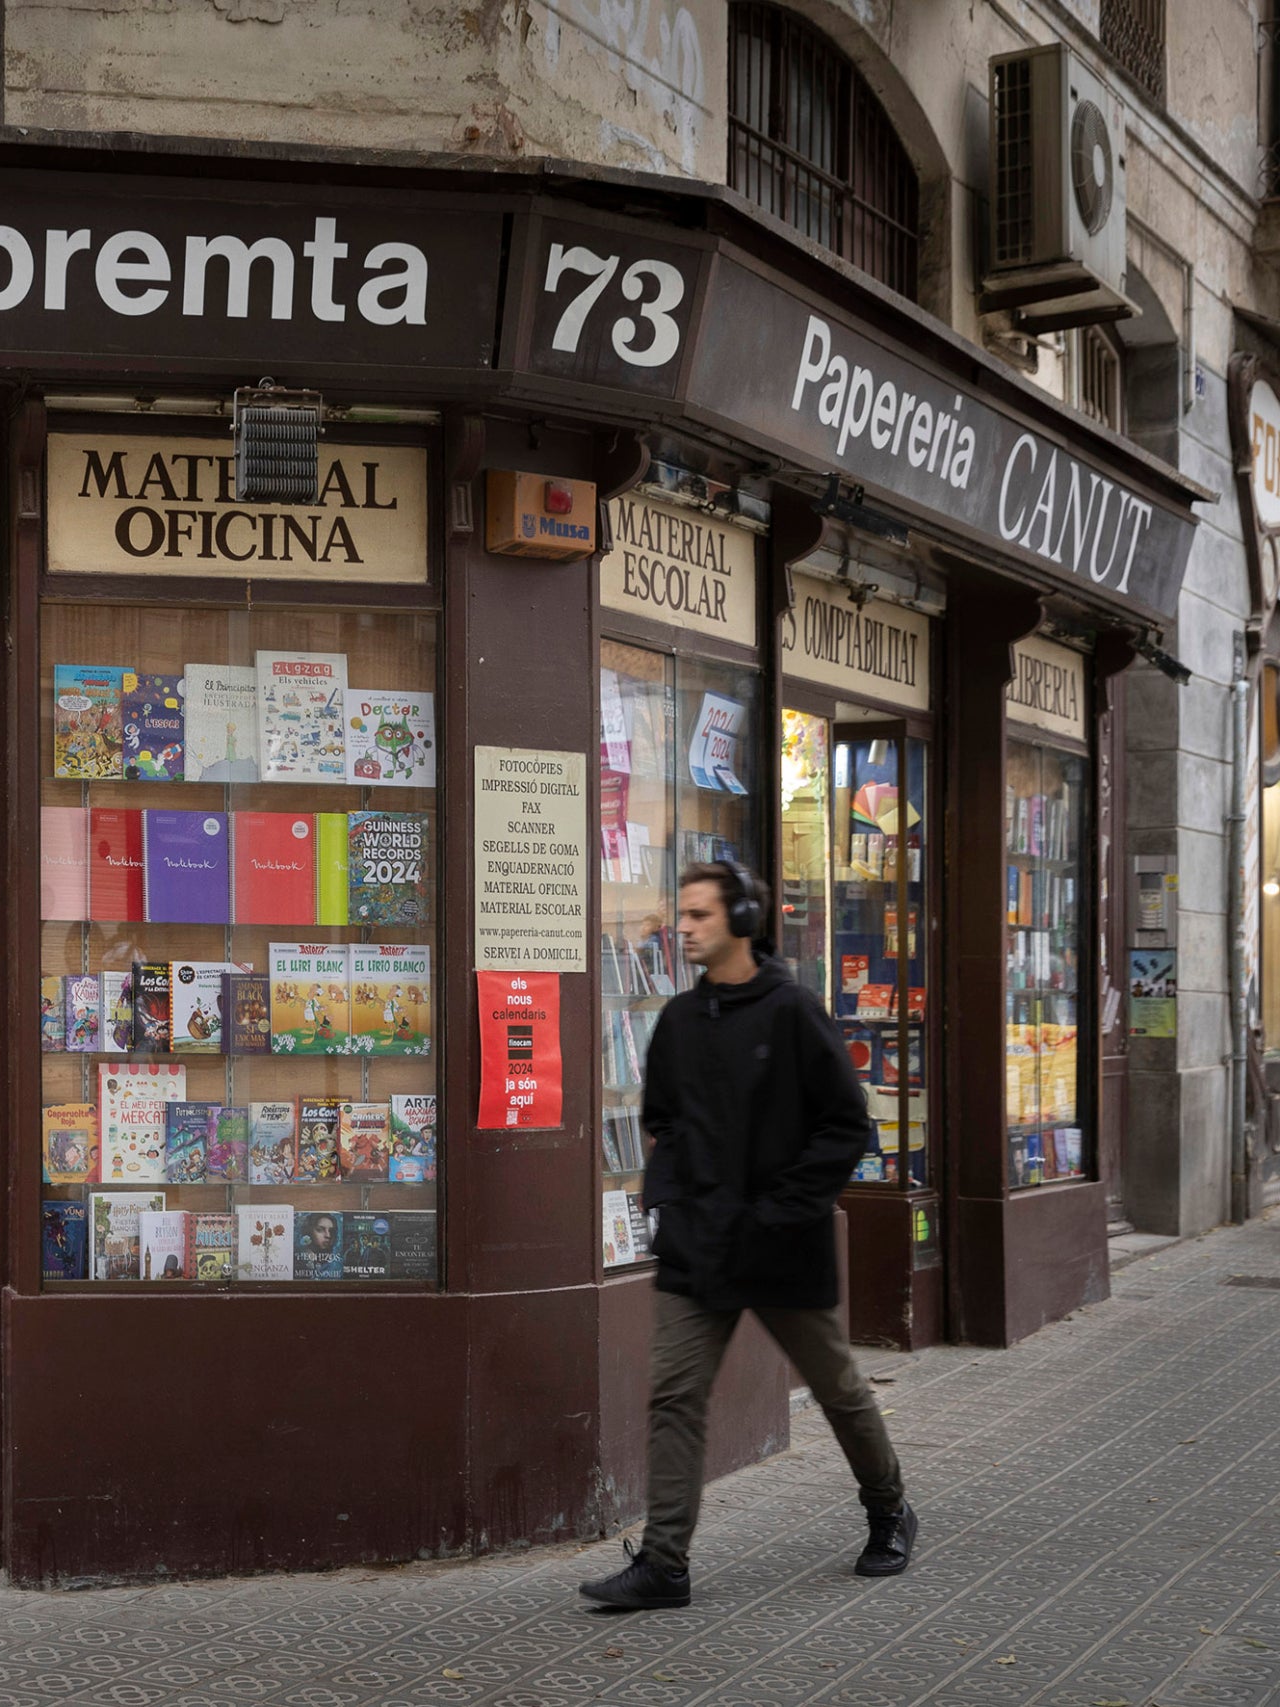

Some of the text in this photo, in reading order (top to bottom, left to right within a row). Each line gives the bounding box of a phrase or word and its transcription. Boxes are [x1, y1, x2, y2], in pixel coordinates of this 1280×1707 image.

[544, 242, 687, 368] 73
[791, 314, 1151, 595] Papereria CANUT
[78, 450, 397, 510] MATEAL
[114, 506, 364, 563] OFICINA
[540, 516, 589, 541] Musa
[616, 498, 731, 576] MATERIAL
[623, 550, 727, 623] ESCOLAR
[804, 596, 917, 687] COMPTABILITAT
[279, 676, 328, 686] Els vehicles
[481, 778, 580, 797] IMPRESSIÓ DIGITAL
[522, 801, 542, 814] FAX
[363, 820, 422, 834] GUINNESS
[507, 820, 556, 835] SCANNER
[363, 833, 422, 849] WORLD
[482, 840, 580, 856] SEGELLS DE GOMA
[363, 848, 422, 861] RECORDS
[163, 856, 218, 870] Notebook
[250, 858, 306, 871] Notebook
[487, 861, 575, 876] ENQUADERNACIÓ
[363, 861, 422, 885] 2024
[483, 881, 578, 896] MATERIAL OFICINA
[480, 901, 581, 916] MATERIAL ESCOLAR
[479, 926, 582, 939] www.papereria-canut.com
[483, 946, 521, 959] SERVEI
[523, 947, 531, 960] A
[276, 960, 286, 972] EL
[316, 960, 343, 973] BLANC
[354, 960, 364, 972] EL
[393, 961, 426, 973] BLANCO
[511, 976, 528, 990] els
[507, 995, 533, 1005] nous
[492, 1008, 546, 1020] calendaris
[508, 1063, 533, 1074] 2024
[505, 1077, 537, 1094] ja són
[120, 1101, 129, 1109] EL
[132, 1101, 147, 1109] MEU
[510, 1092, 534, 1109] aquí
[120, 1111, 168, 1124] MERCAT
[343, 1265, 385, 1275] SHELTER
